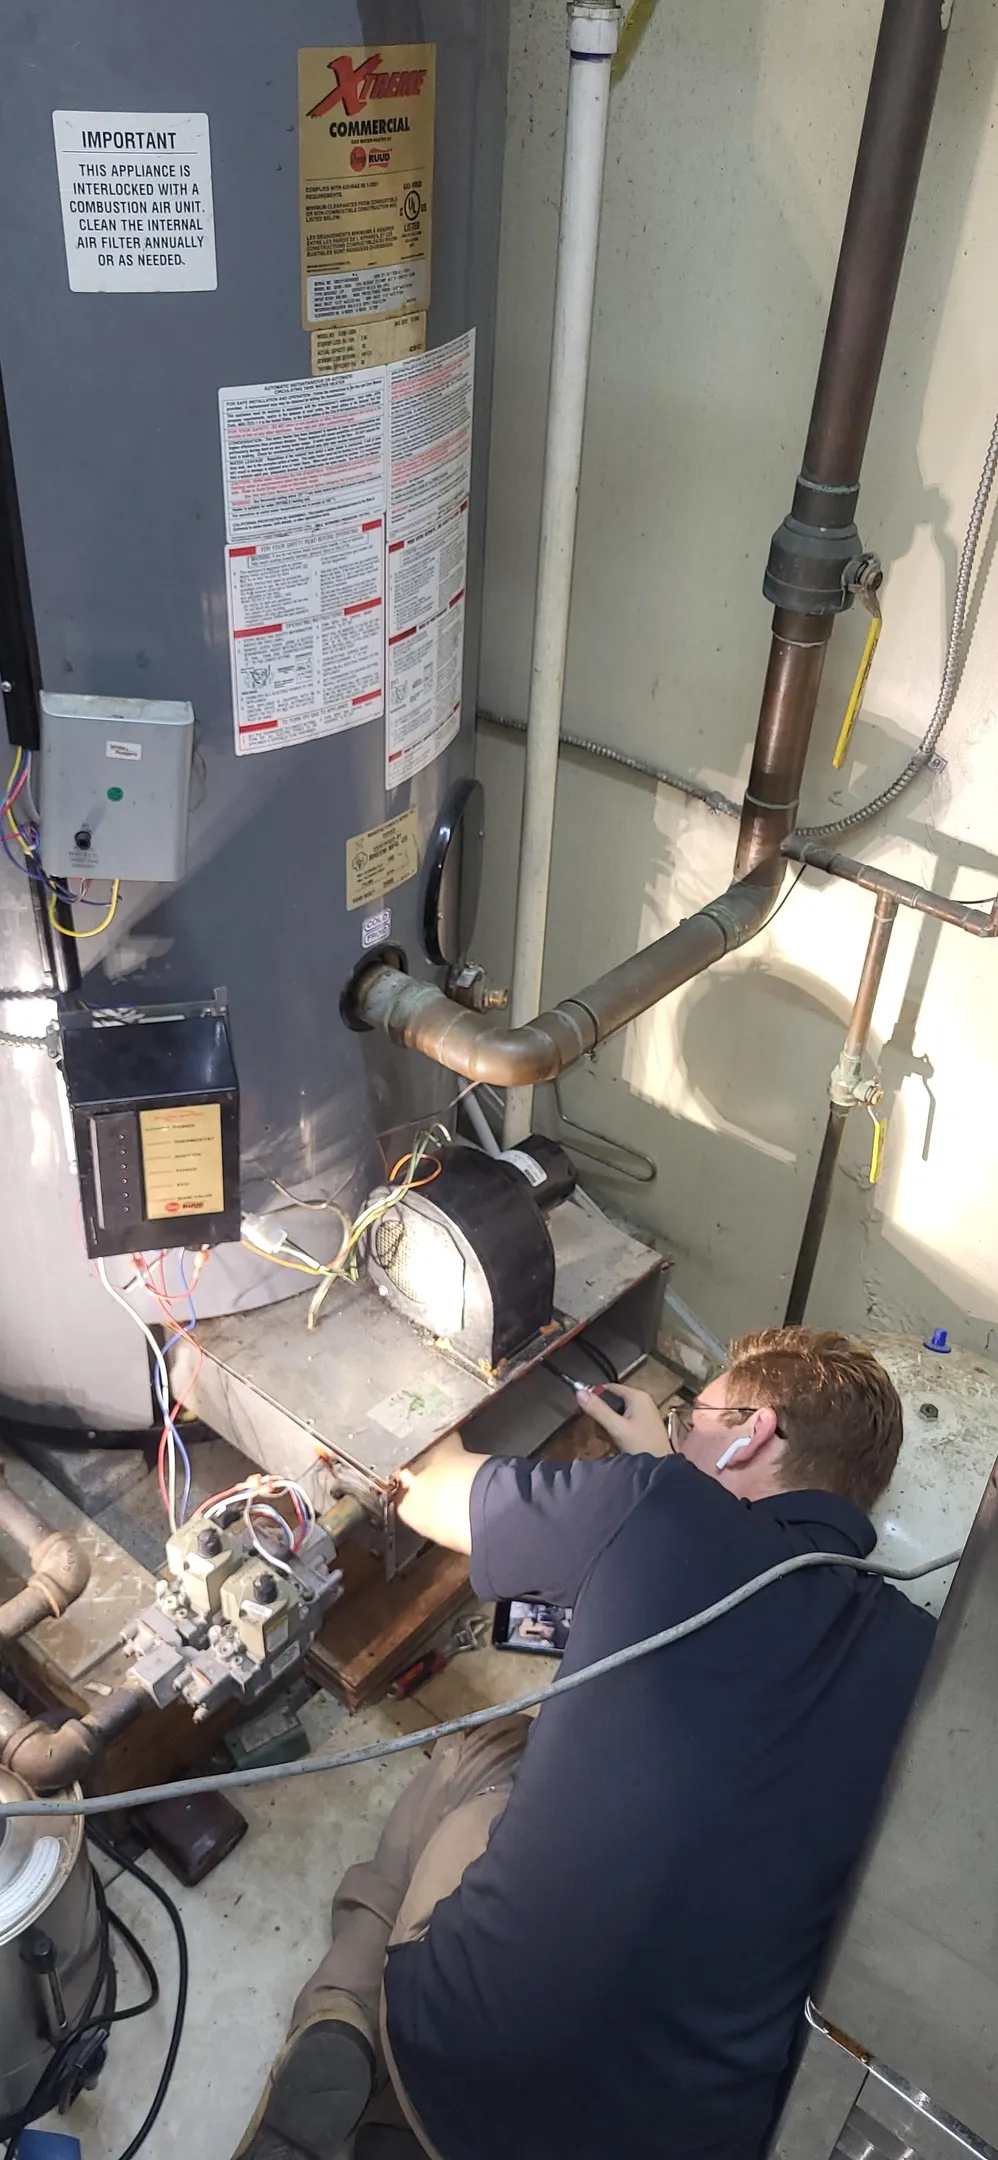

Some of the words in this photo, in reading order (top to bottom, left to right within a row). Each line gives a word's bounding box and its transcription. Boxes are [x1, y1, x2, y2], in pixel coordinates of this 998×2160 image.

[306, 53, 427, 118] XTREME
[329, 117, 410, 137] COMMERCIAL
[81, 130, 177, 149] IMPORTANT
[369, 153, 390, 163] RUUD
[78, 164, 107, 177] THIS
[110, 164, 176, 178] APPLIANCE
[180, 165, 191, 178] IS
[73, 183, 154, 196] INTERLOCKED
[158, 183, 187, 196] WITH
[191, 183, 200, 196] A
[69, 200, 147, 214] COMBUSTION
[151, 201, 171, 214] AIR
[174, 201, 206, 214] UNIT.
[408, 196, 417, 214] UL
[79, 219, 117, 231] CLEAN
[120, 219, 144, 231] THE
[147, 219, 204, 232] INTERNAL
[77, 236, 97, 249] AIR
[101, 236, 141, 250] FILTER
[144, 236, 205, 249] ANNUALLY
[97, 254, 114, 266] OR
[118, 254, 134, 267] AS
[367, 913, 388, 928] COLD
[367, 926, 387, 941] FROID
